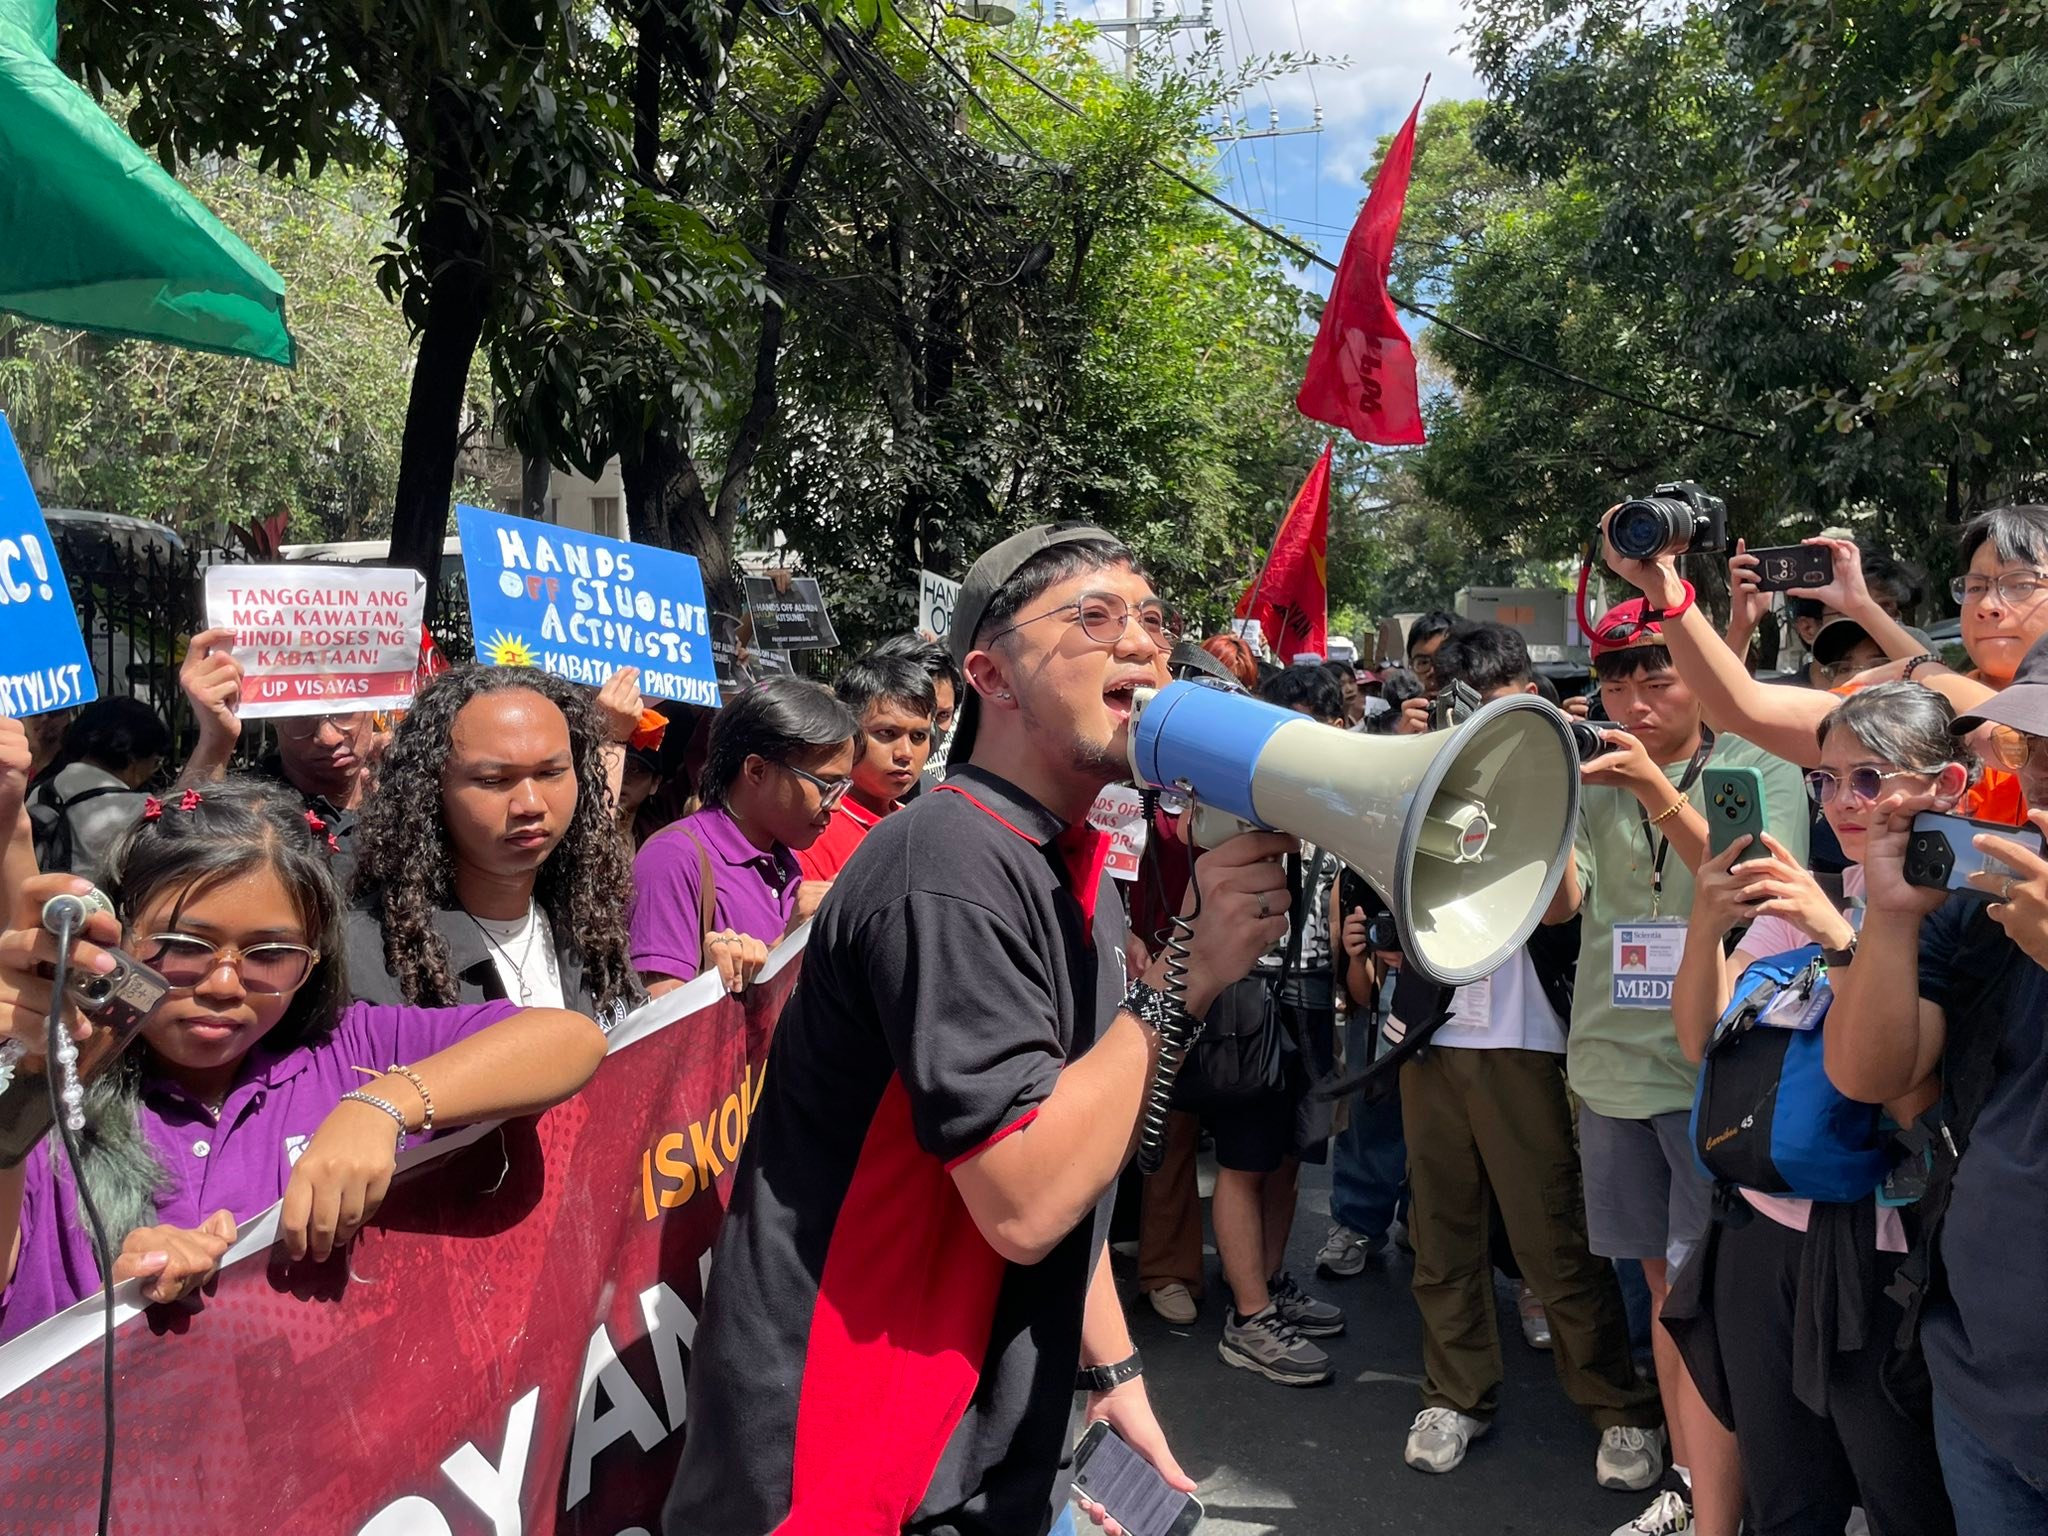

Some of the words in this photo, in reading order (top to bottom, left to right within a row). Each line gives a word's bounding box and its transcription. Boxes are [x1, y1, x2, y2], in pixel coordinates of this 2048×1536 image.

[497, 528, 634, 581] HANDS
[499, 570, 560, 601] OFF
[227, 588, 358, 606] TANGGALIN
[366, 591, 408, 606] ANG
[756, 603, 780, 612] HANDS
[780, 603, 794, 612] OFF
[233, 610, 285, 626] MGA
[294, 610, 404, 629] KAWATAN,
[232, 630, 292, 647] HINDI
[300, 630, 370, 646] BOSES
[377, 630, 405, 646] NG
[258, 649, 379, 666] KABATAAN!
[262, 681, 288, 698] UP
[294, 678, 369, 696] VISAYAS
[644, 669, 718, 705] PARTYLIST
[1634, 931, 1661, 939] Scientia
[1616, 980, 1674, 999] MEDI
[1741, 1115, 1753, 1128] 45
